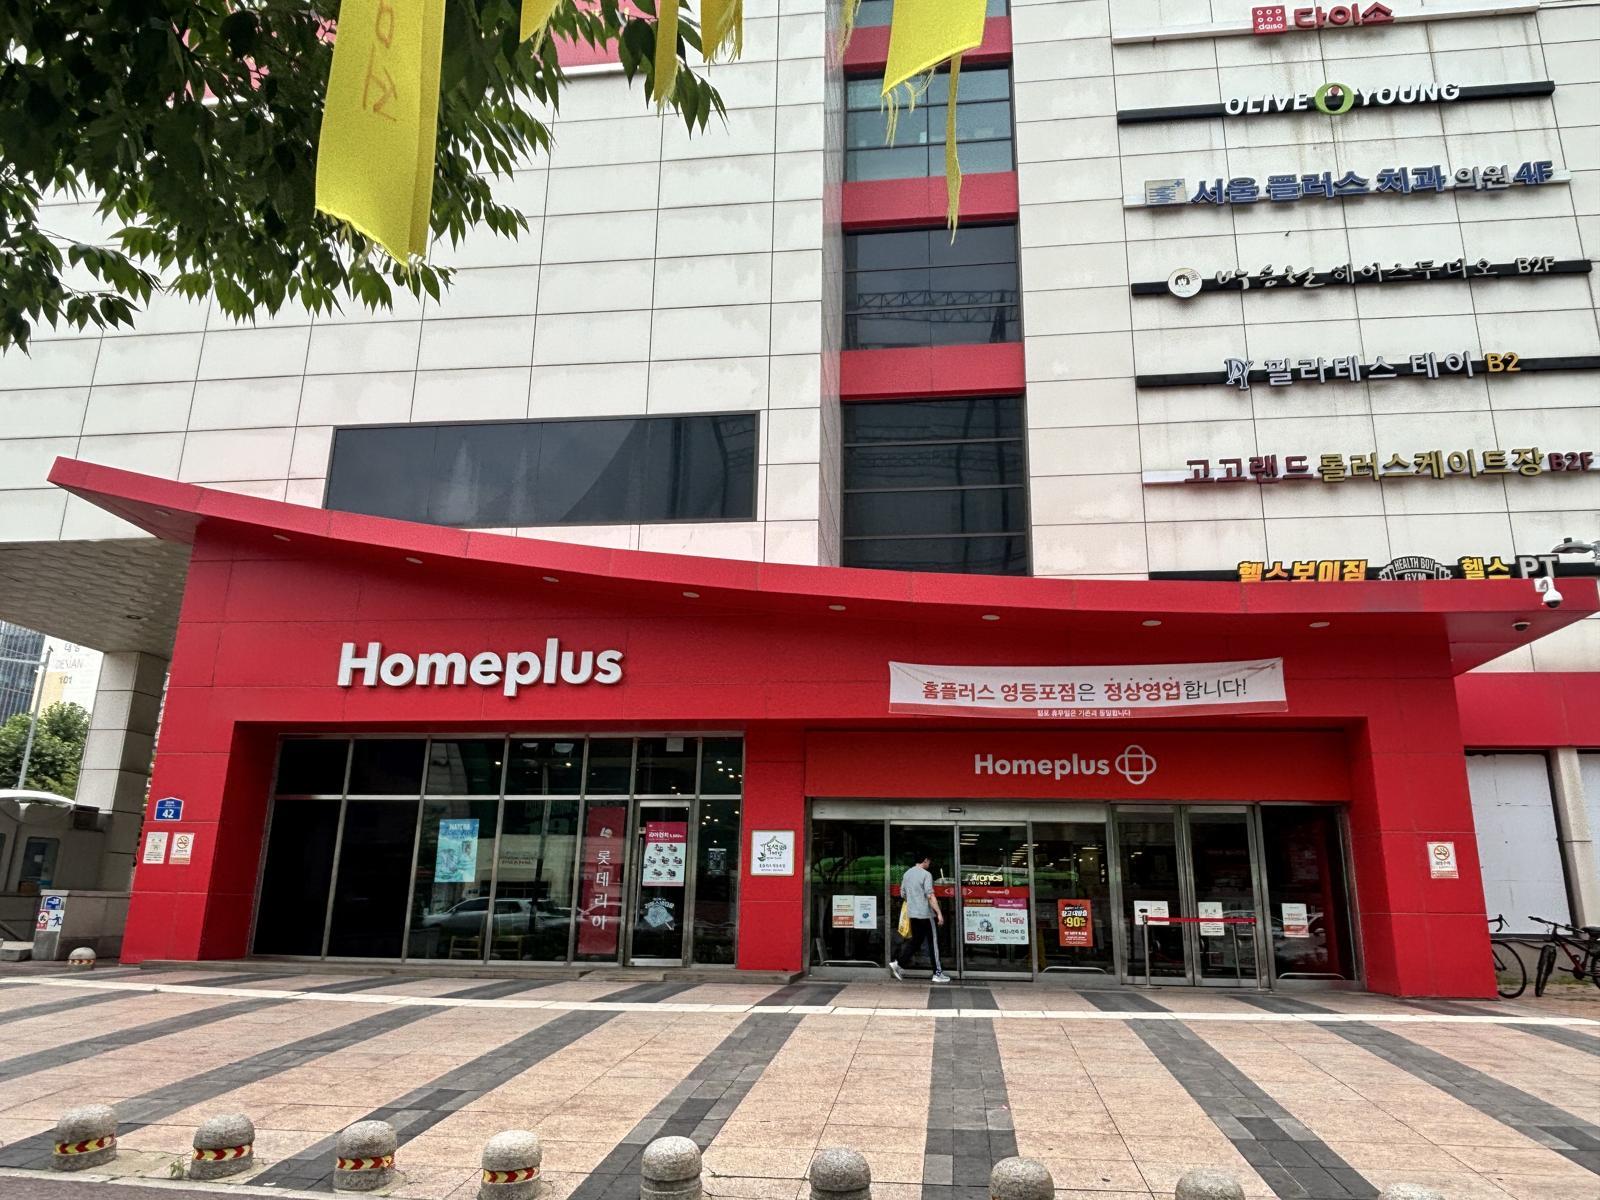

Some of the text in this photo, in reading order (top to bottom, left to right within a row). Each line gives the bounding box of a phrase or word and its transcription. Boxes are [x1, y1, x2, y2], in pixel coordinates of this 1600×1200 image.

[1294, 1, 1395, 28] 다이소
[1225, 82, 1461, 115] OLIVE YOUNG
[1191, 160, 1553, 205] 서울 플러스 치과 의원 4F
[1516, 256, 1556, 274] B2F
[1264, 350, 1522, 387] 필라테스 데이 B2
[1318, 447, 1545, 483] 롤러스케이트장
[1547, 451, 1594, 473] B2F
[1238, 560, 1368, 582] 헬스보이짐
[1461, 555, 1558, 580] 헬스 PT
[337, 638, 624, 697] Homeplus
[922, 677, 1247, 703] 홈플러스 영등포점은 정상영업합니다!
[974, 753, 1110, 780] Homeplus
[162, 809, 175, 819] 42
[592, 850, 611, 930] 롯데리아
